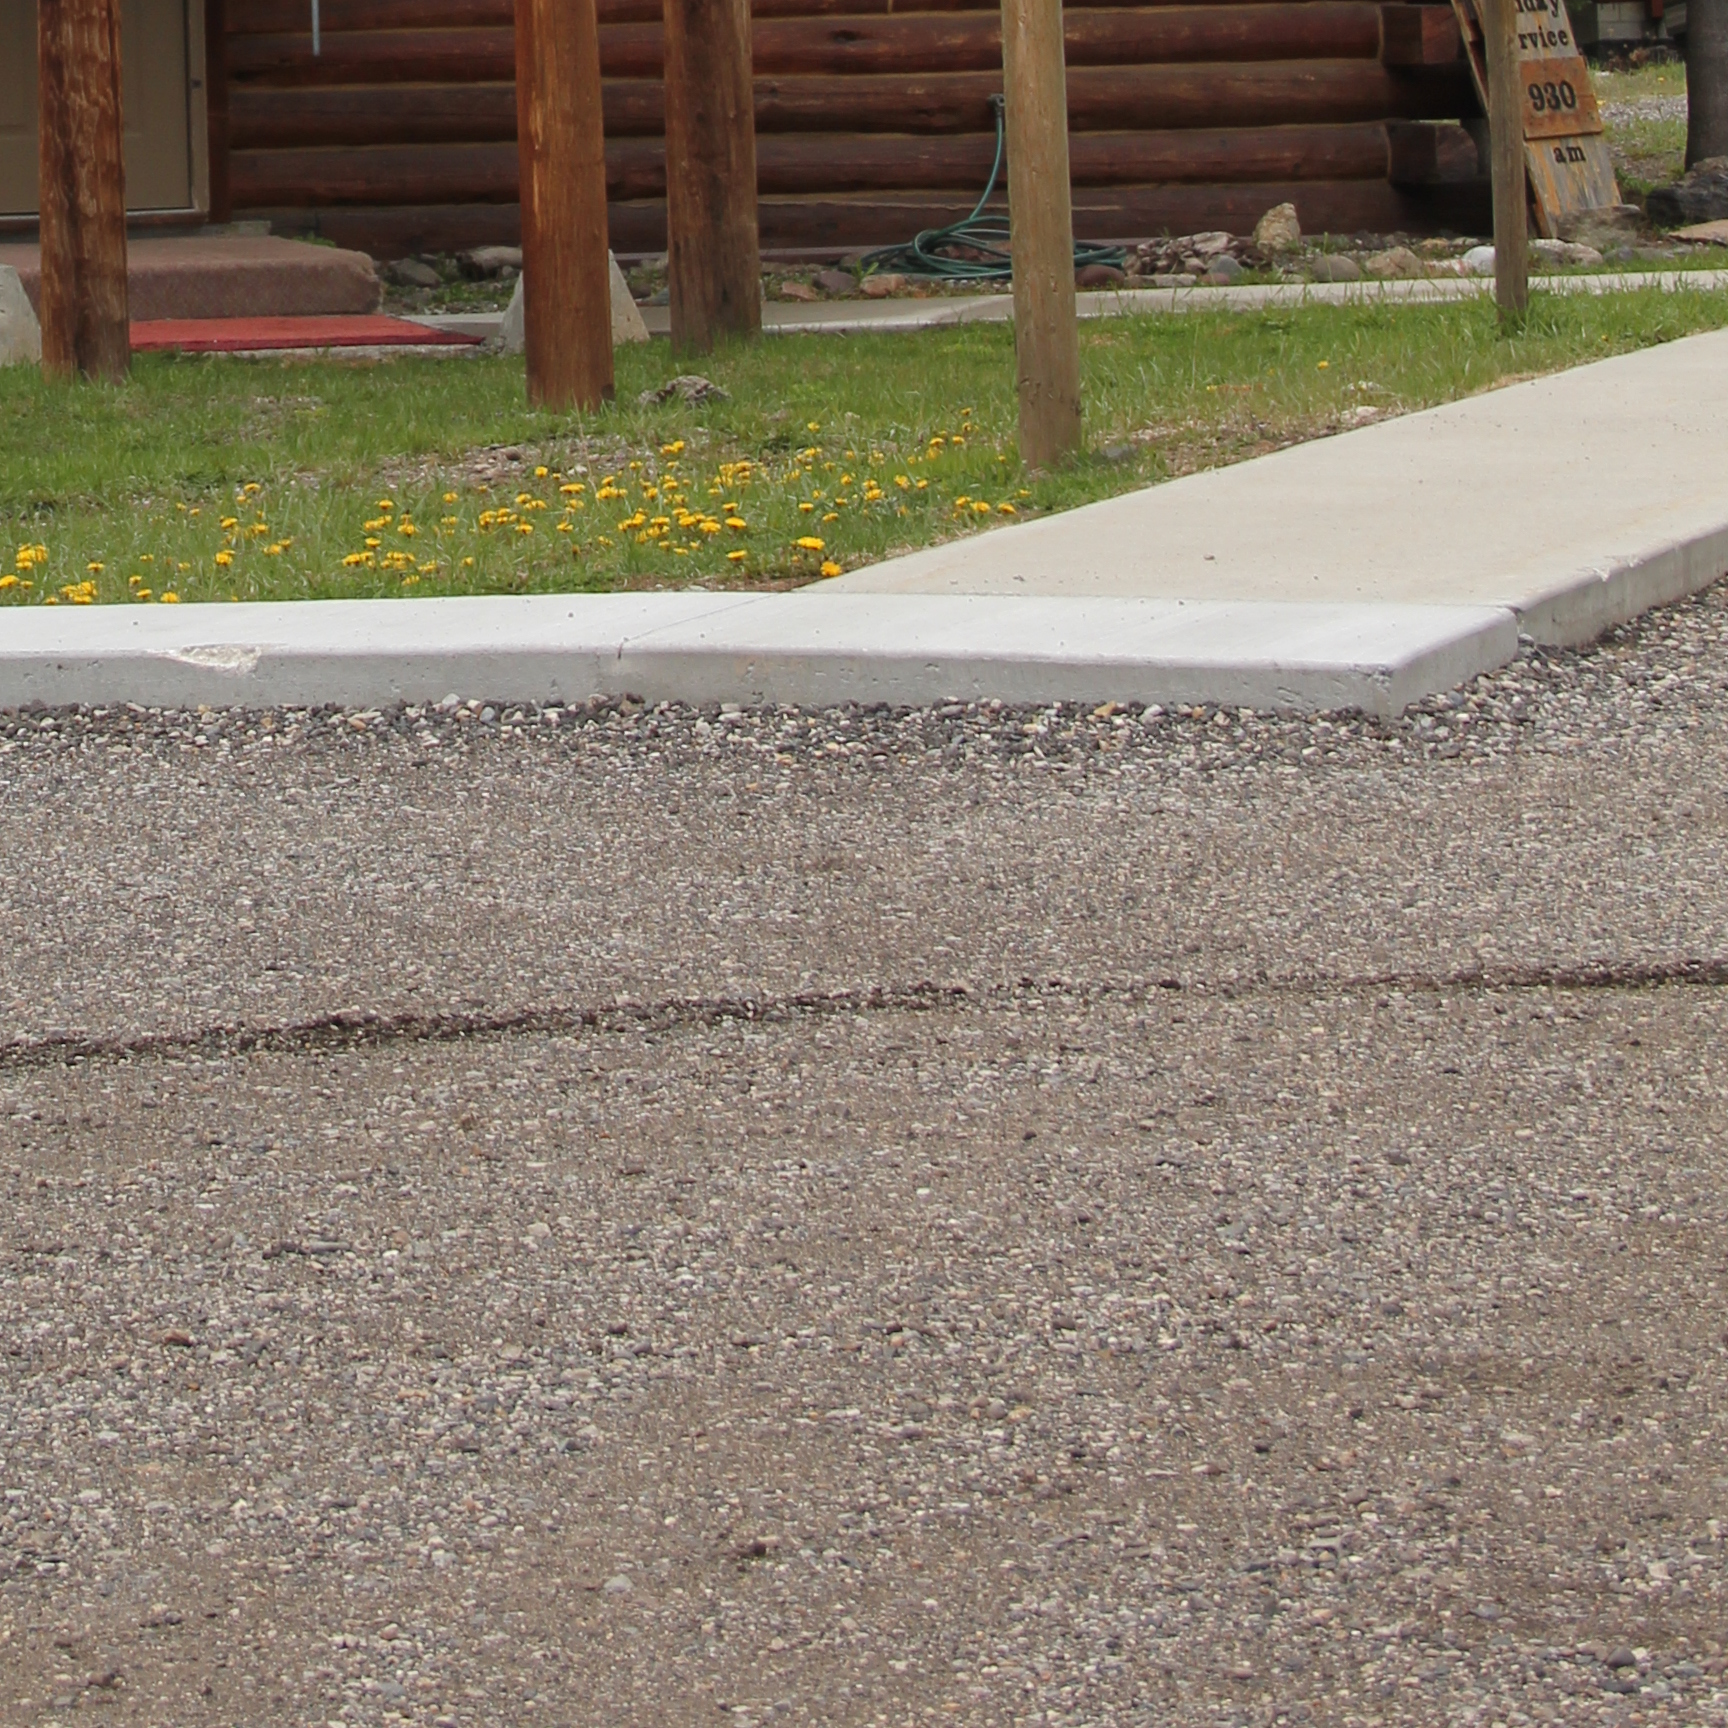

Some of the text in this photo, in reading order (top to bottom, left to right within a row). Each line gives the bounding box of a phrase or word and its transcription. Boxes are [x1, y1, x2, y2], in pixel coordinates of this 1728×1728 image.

[1518, 25, 1568, 49] rvice
[1528, 80, 1576, 112] 930
[1553, 146, 1586, 163] am
